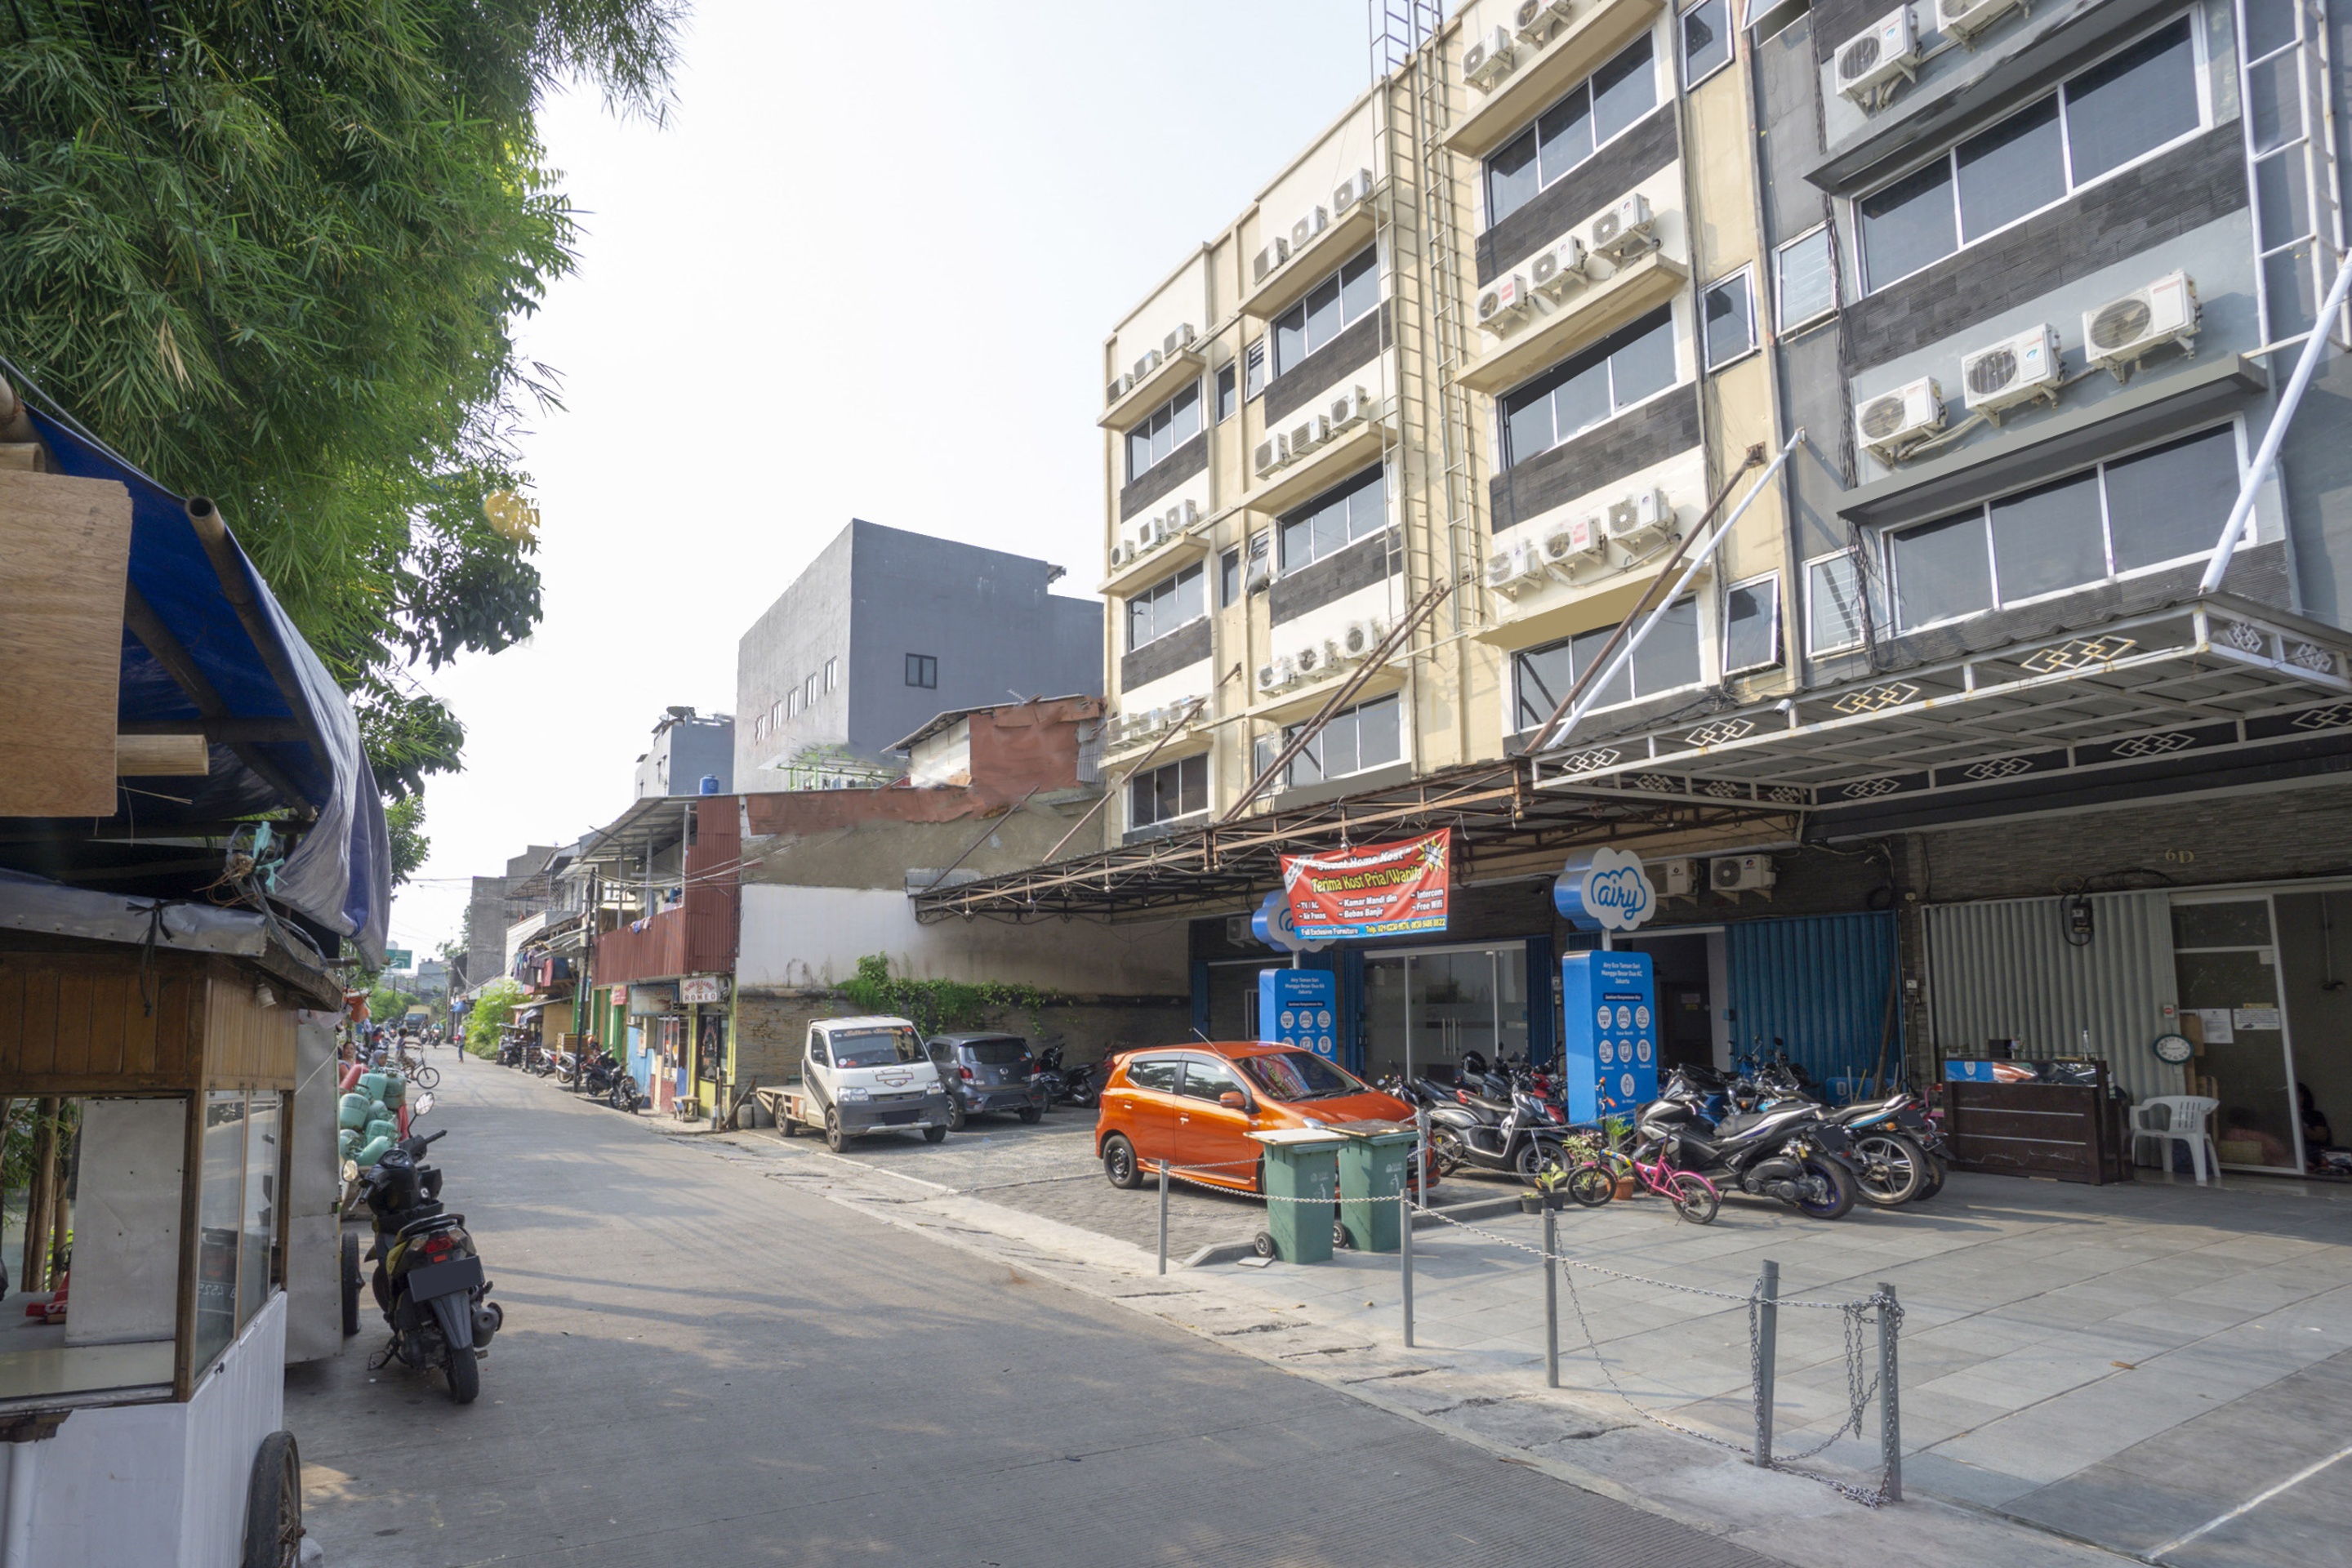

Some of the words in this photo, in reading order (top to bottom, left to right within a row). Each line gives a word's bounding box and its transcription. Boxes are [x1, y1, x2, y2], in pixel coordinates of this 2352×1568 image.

[1348, 856, 1378, 868] Home
[1379, 850, 1404, 863] Kost
[1312, 876, 1343, 893] Terima
[1342, 875, 1365, 890] Kost
[1364, 866, 1423, 888] Pria/Wanita
[1417, 889, 1444, 899] Intercom
[1597, 879, 1638, 920] airy
[1343, 898, 1365, 907] Kamar
[1365, 895, 1385, 905] Mandi
[1416, 902, 1430, 911] Free
[1343, 910, 1364, 919] Bebas
[1365, 907, 1383, 917] Banjir
[1310, 928, 1333, 936] Exclusive
[1333, 927, 1358, 936] Furniture
[684, 993, 716, 1001] ROMEO
